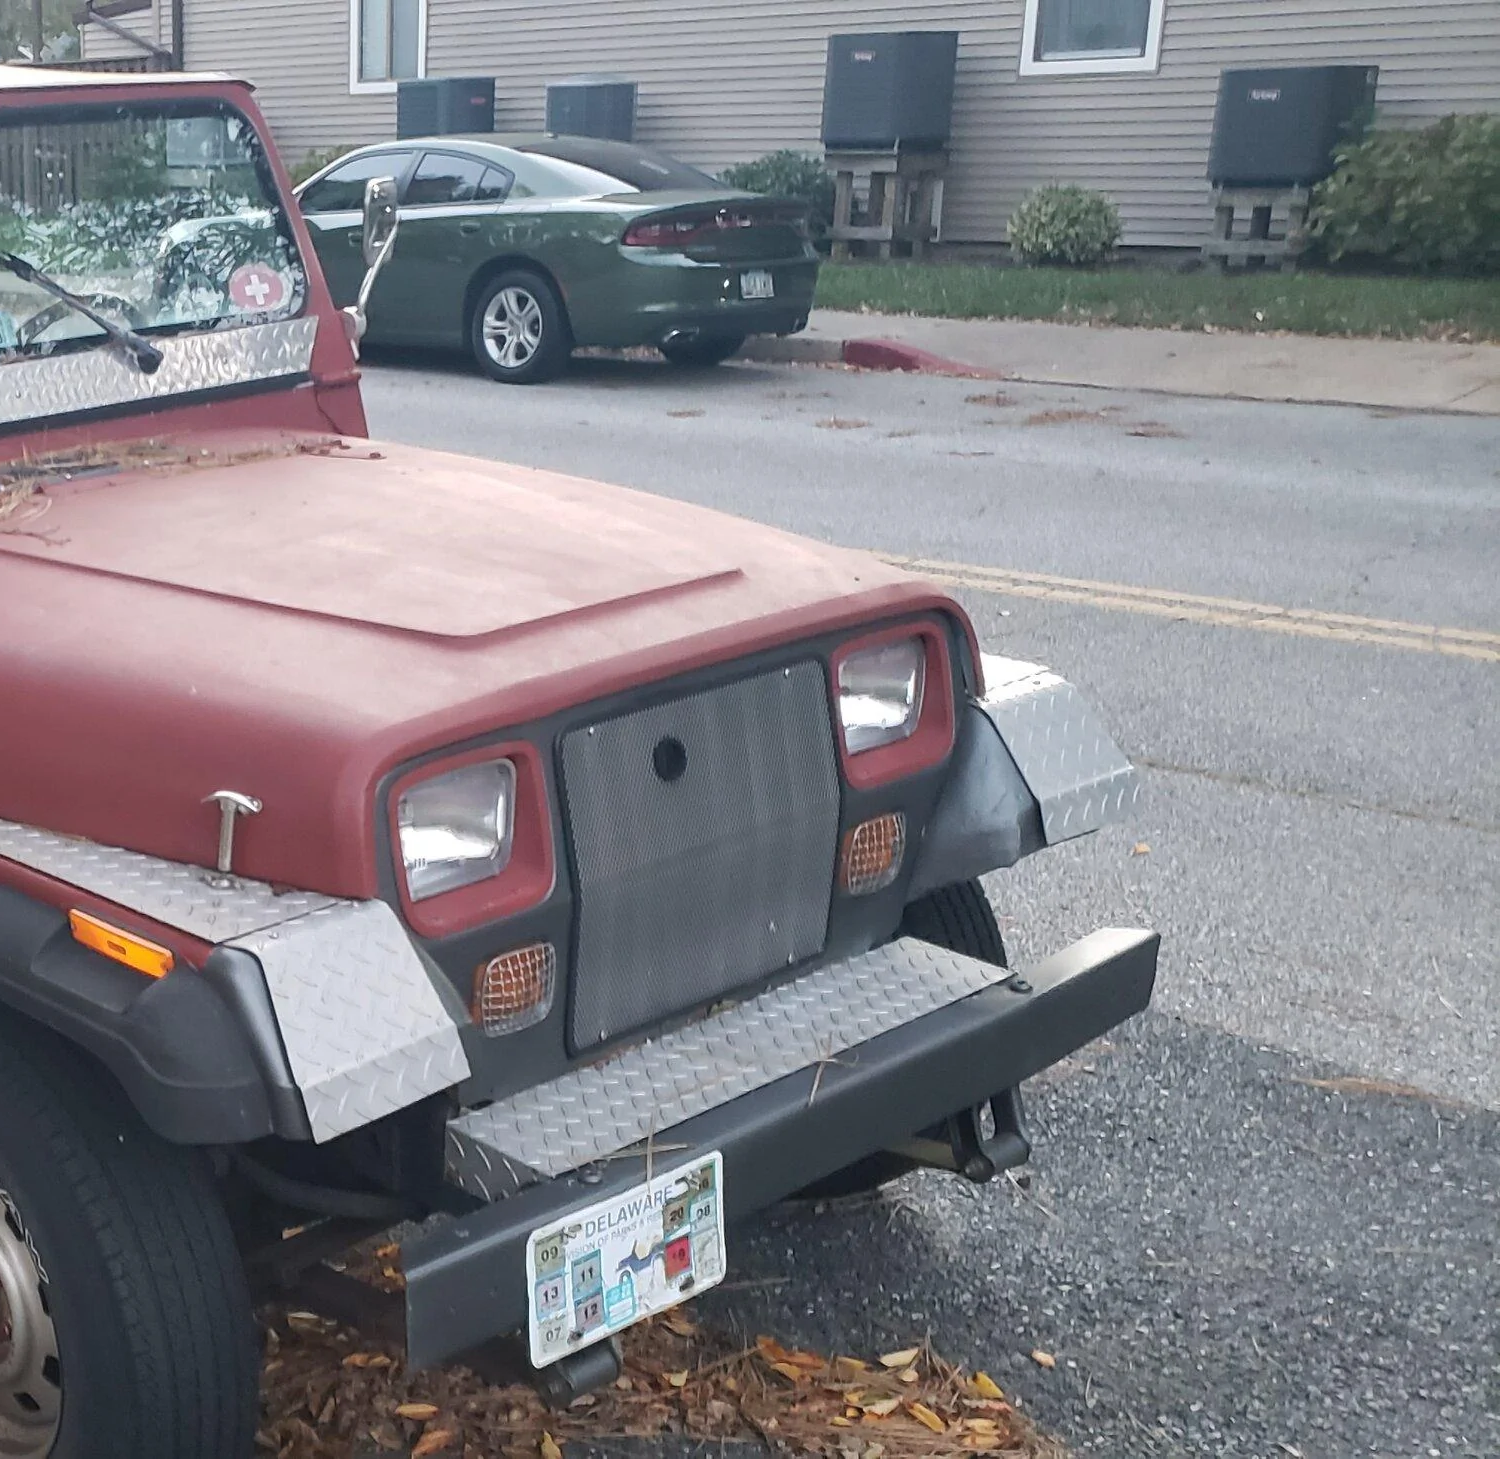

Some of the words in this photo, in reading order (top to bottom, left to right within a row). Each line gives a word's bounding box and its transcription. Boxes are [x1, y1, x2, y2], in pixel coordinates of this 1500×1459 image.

[585, 1184, 674, 1239] DELAWARE
[669, 1206, 684, 1222] 20
[541, 1246, 559, 1262] 09
[581, 1266, 594, 1283] 11
[543, 1286, 559, 1304] 13
[584, 1303, 598, 1320] 12
[546, 1326, 562, 1343] 07
